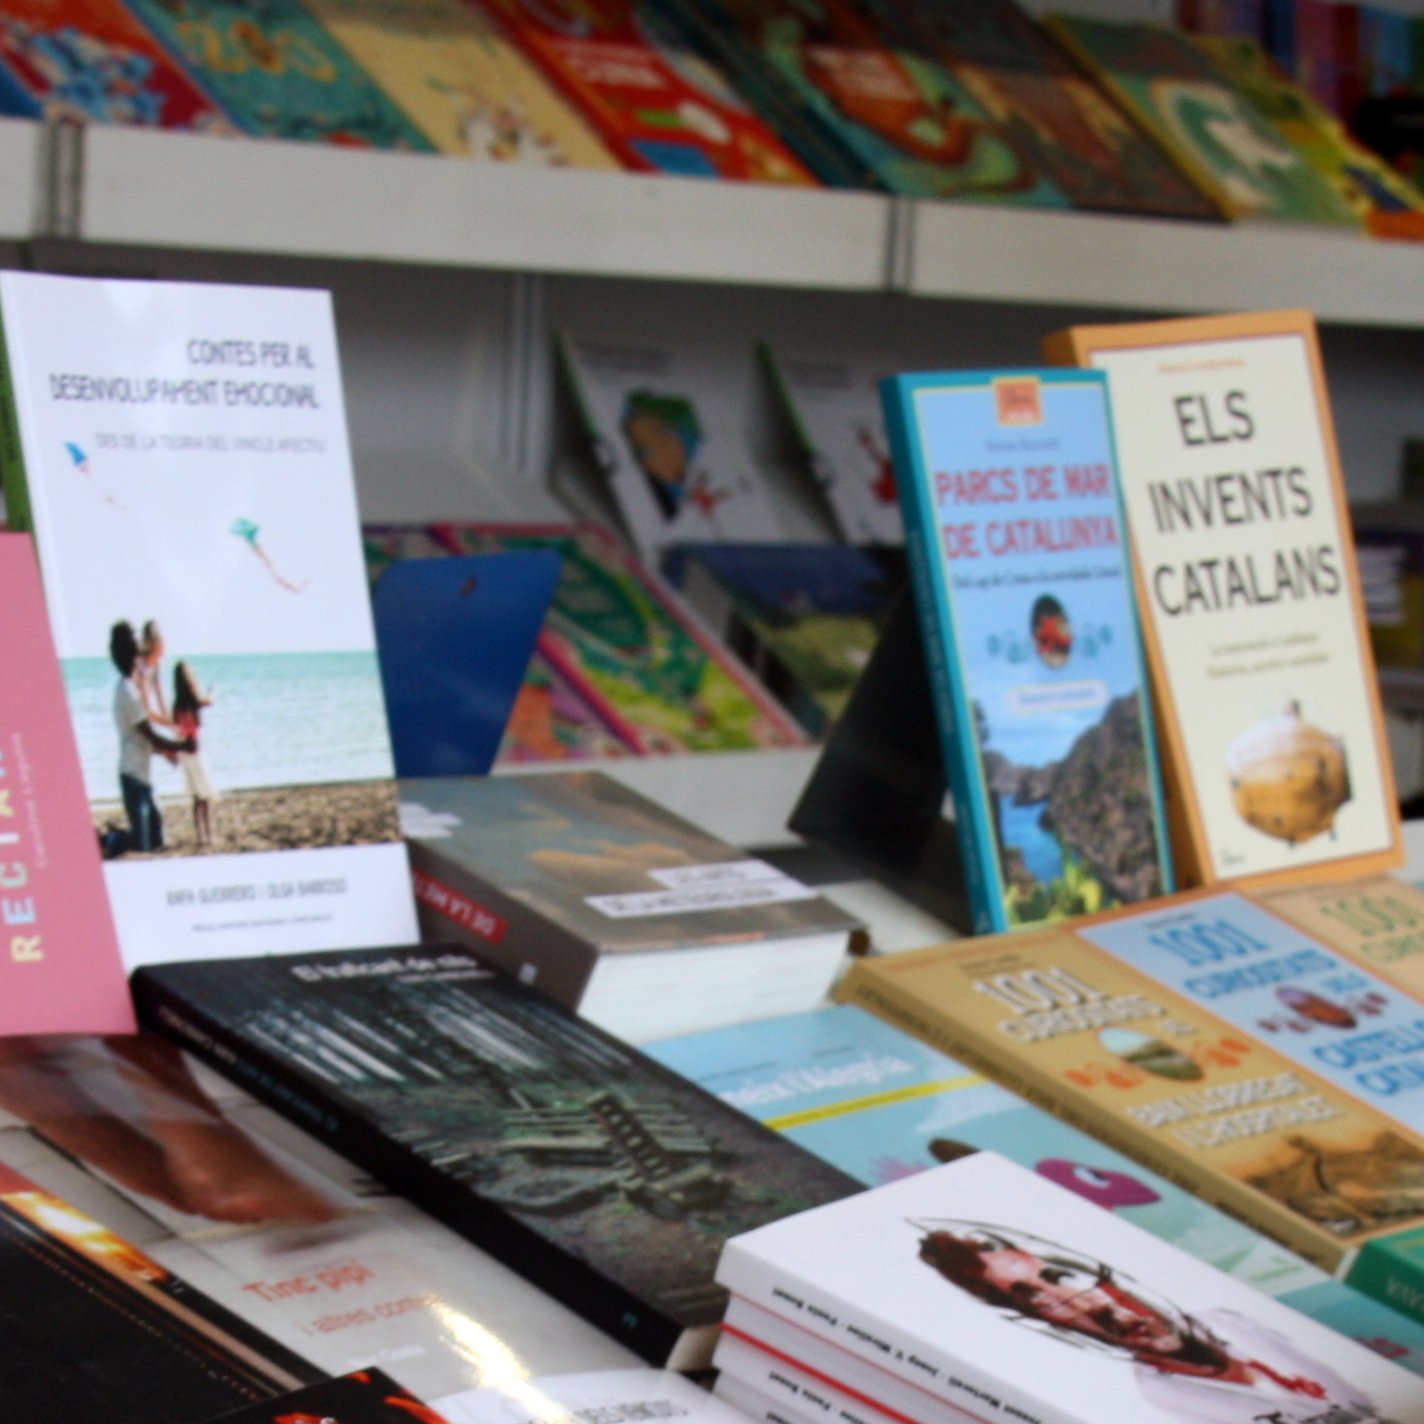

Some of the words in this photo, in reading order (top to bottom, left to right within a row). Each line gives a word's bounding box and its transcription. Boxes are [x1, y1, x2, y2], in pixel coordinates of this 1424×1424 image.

[187, 339, 257, 367] CONTES
[260, 342, 290, 368] PER
[293, 344, 315, 369] AL
[50, 373, 219, 405] DESENVOLUPAMENT
[223, 379, 320, 409] EMOCIONAL
[1173, 390, 1255, 447] ELS
[934, 467, 1020, 506] PARCS
[1027, 465, 1057, 497] DE
[1063, 462, 1112, 498] MAR
[1148, 467, 1314, 536] INVENTS
[943, 523, 981, 560] DE
[985, 515, 1118, 556] CATALUNYA
[1152, 544, 1341, 616] CATALANS
[1148, 918, 1270, 966] 1001
[975, 967, 1108, 1016] 1001
